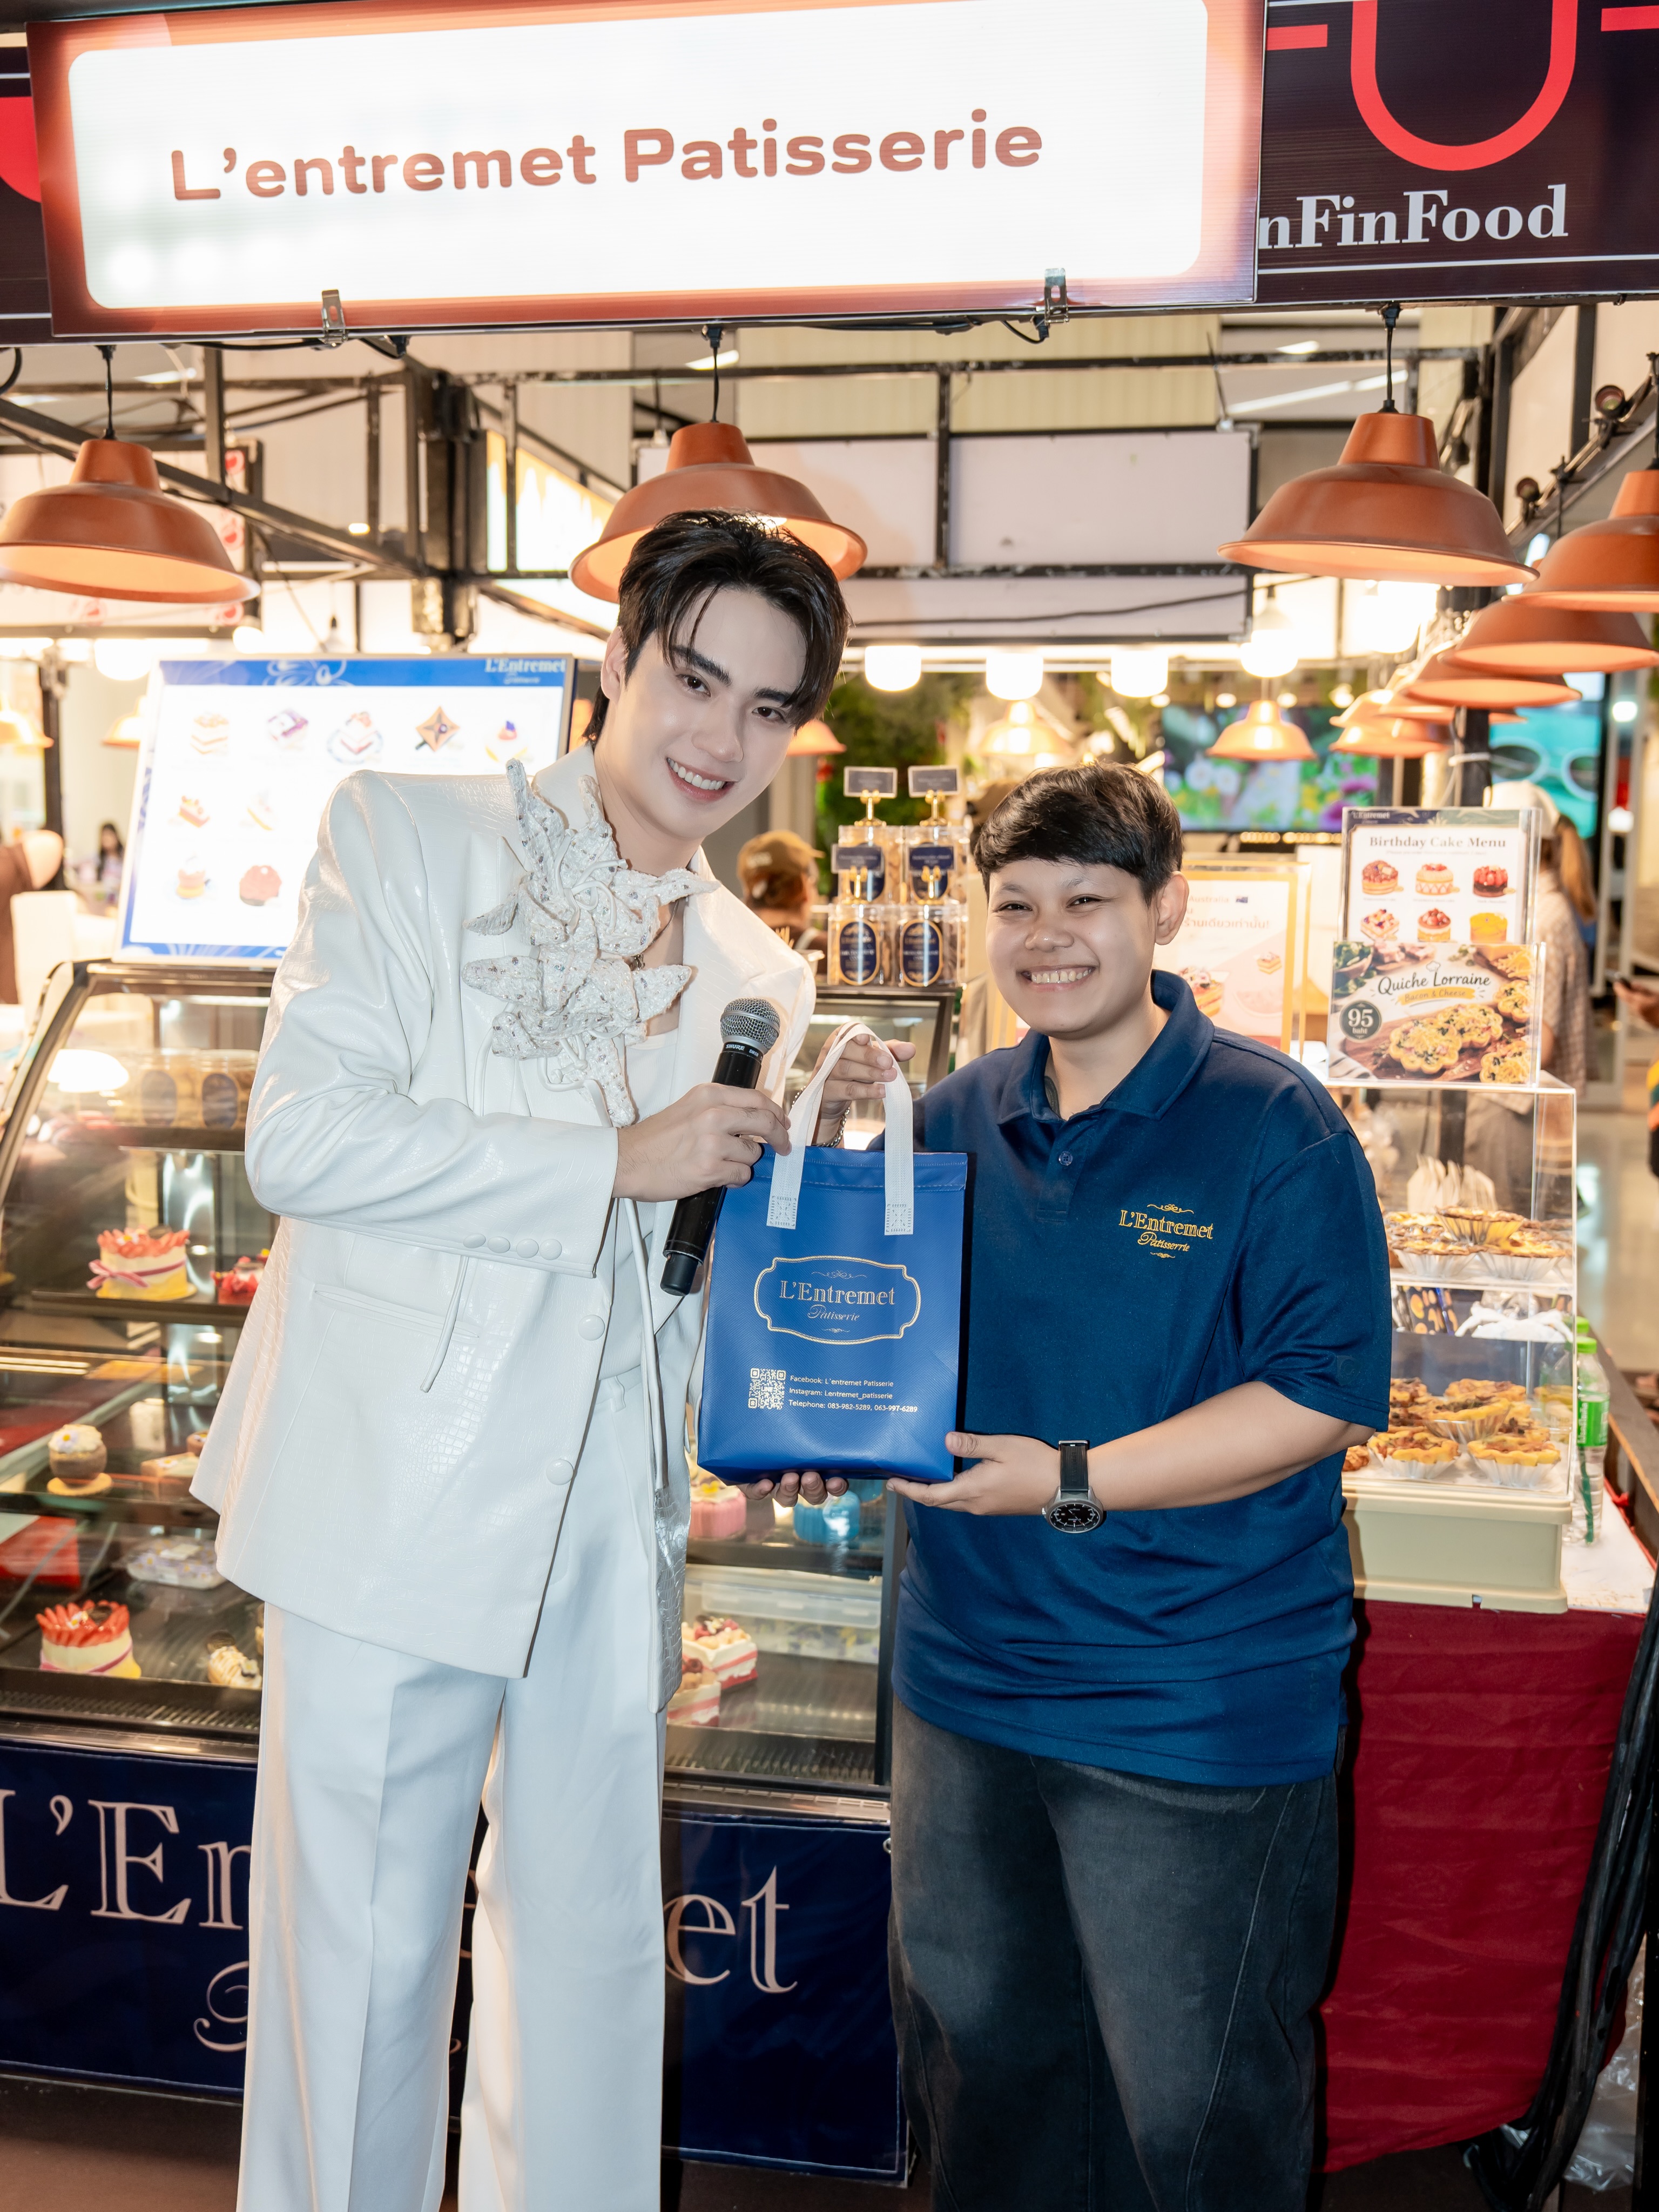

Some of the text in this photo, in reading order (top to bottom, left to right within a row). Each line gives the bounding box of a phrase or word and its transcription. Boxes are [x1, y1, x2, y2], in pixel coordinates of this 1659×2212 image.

[172, 109, 1042, 200] L'entremet Patisserie
[1370, 837, 1507, 849] Birthday Cake Menu
[1378, 972, 1491, 995] Quiche Lorraine
[1405, 991, 1429, 1001] Bacon
[1439, 989, 1466, 997] Cheese
[1348, 1008, 1373, 1027] 95
[1118, 1210, 1213, 1239] L'Entremet
[779, 1280, 895, 1305] L'Entremet
[807, 1304, 860, 1321] Patisserie
[790, 1375, 822, 1384] Facebook:
[789, 1387, 893, 1400] Instagram: Lentremet_patisserie
[788, 1399, 918, 1413] Telephone: 083-982-5289, 063-997-6289
